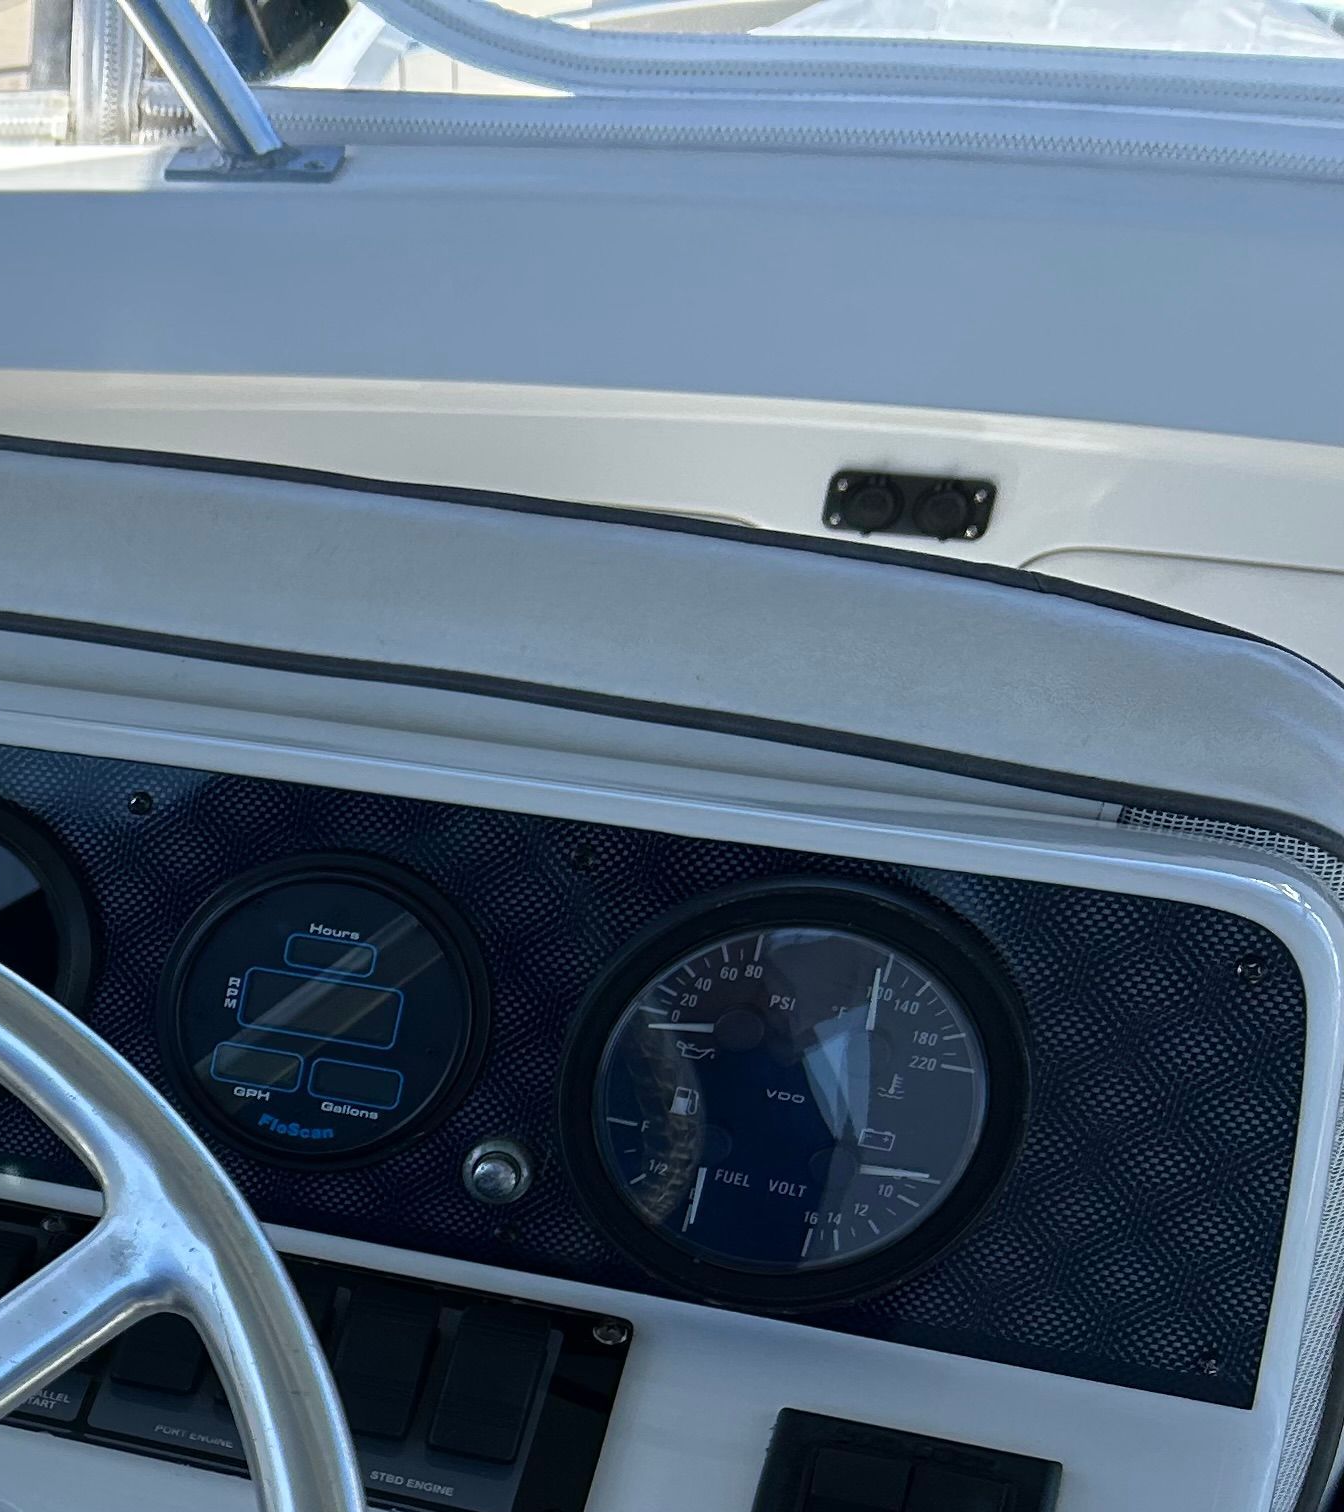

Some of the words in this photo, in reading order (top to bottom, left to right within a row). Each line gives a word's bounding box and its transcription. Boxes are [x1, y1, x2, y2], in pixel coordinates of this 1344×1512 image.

[310, 923, 360, 940] Hours
[720, 967, 738, 981] 60
[745, 966, 763, 979] 80
[694, 977, 712, 992] 40
[680, 993, 698, 1007] 20
[769, 995, 796, 1011] PSI
[894, 999, 919, 1015] 140
[671, 1009, 680, 1023] 0
[913, 1031, 938, 1046] 180
[909, 1055, 937, 1071] 220
[233, 1086, 270, 1101] GPH
[321, 1102, 378, 1119] Gallons
[766, 1089, 804, 1104] VDO
[258, 1113, 334, 1139] FloScan
[649, 1159, 668, 1175] 1/2
[715, 1169, 750, 1188] FUEL
[768, 1179, 808, 1197] VOLT
[878, 1184, 893, 1197] 10
[854, 1203, 869, 1216] 12
[804, 1211, 818, 1224] 16
[827, 1212, 842, 1225] 14
[370, 1471, 404, 1486] STBD
[407, 1479, 453, 1496] ENGINE
